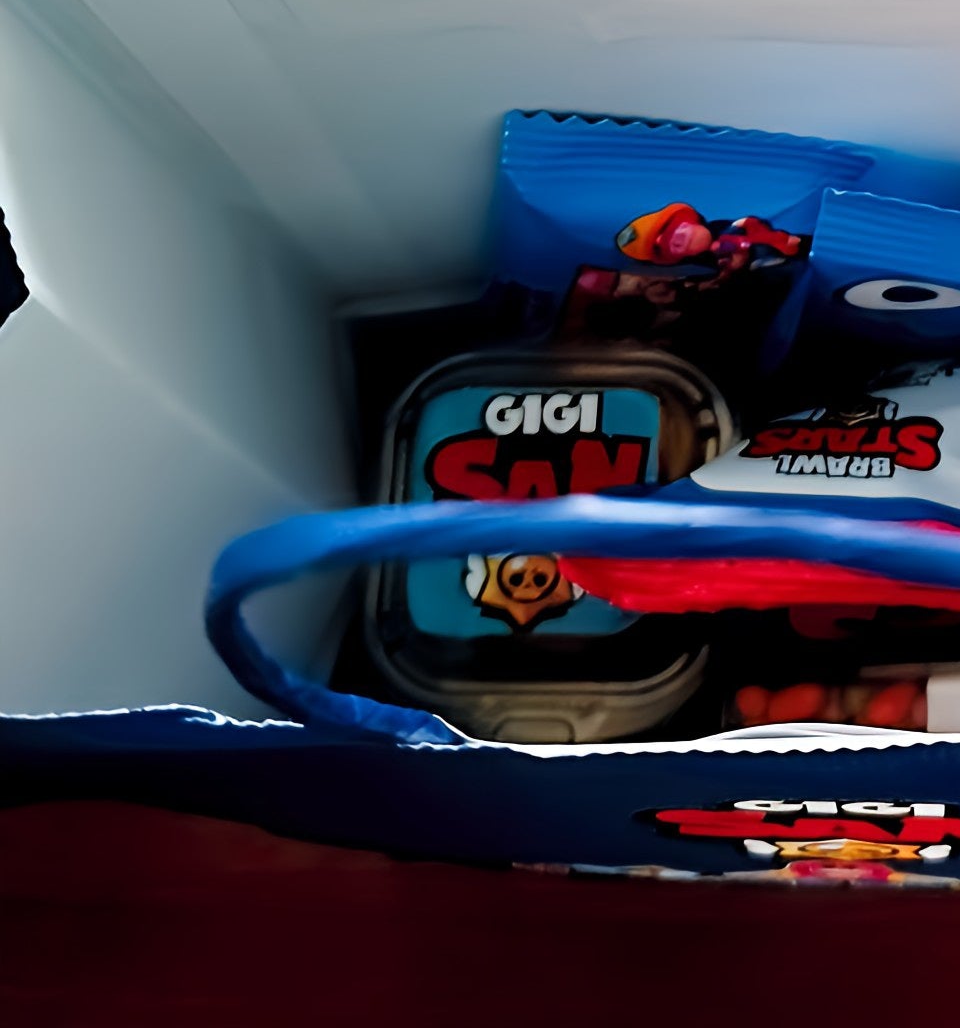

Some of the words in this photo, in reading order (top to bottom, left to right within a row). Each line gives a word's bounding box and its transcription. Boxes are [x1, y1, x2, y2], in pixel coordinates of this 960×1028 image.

[484, 392, 600, 436] GIGI
[748, 424, 942, 471] STARS
[776, 453, 892, 479] BRAWL
